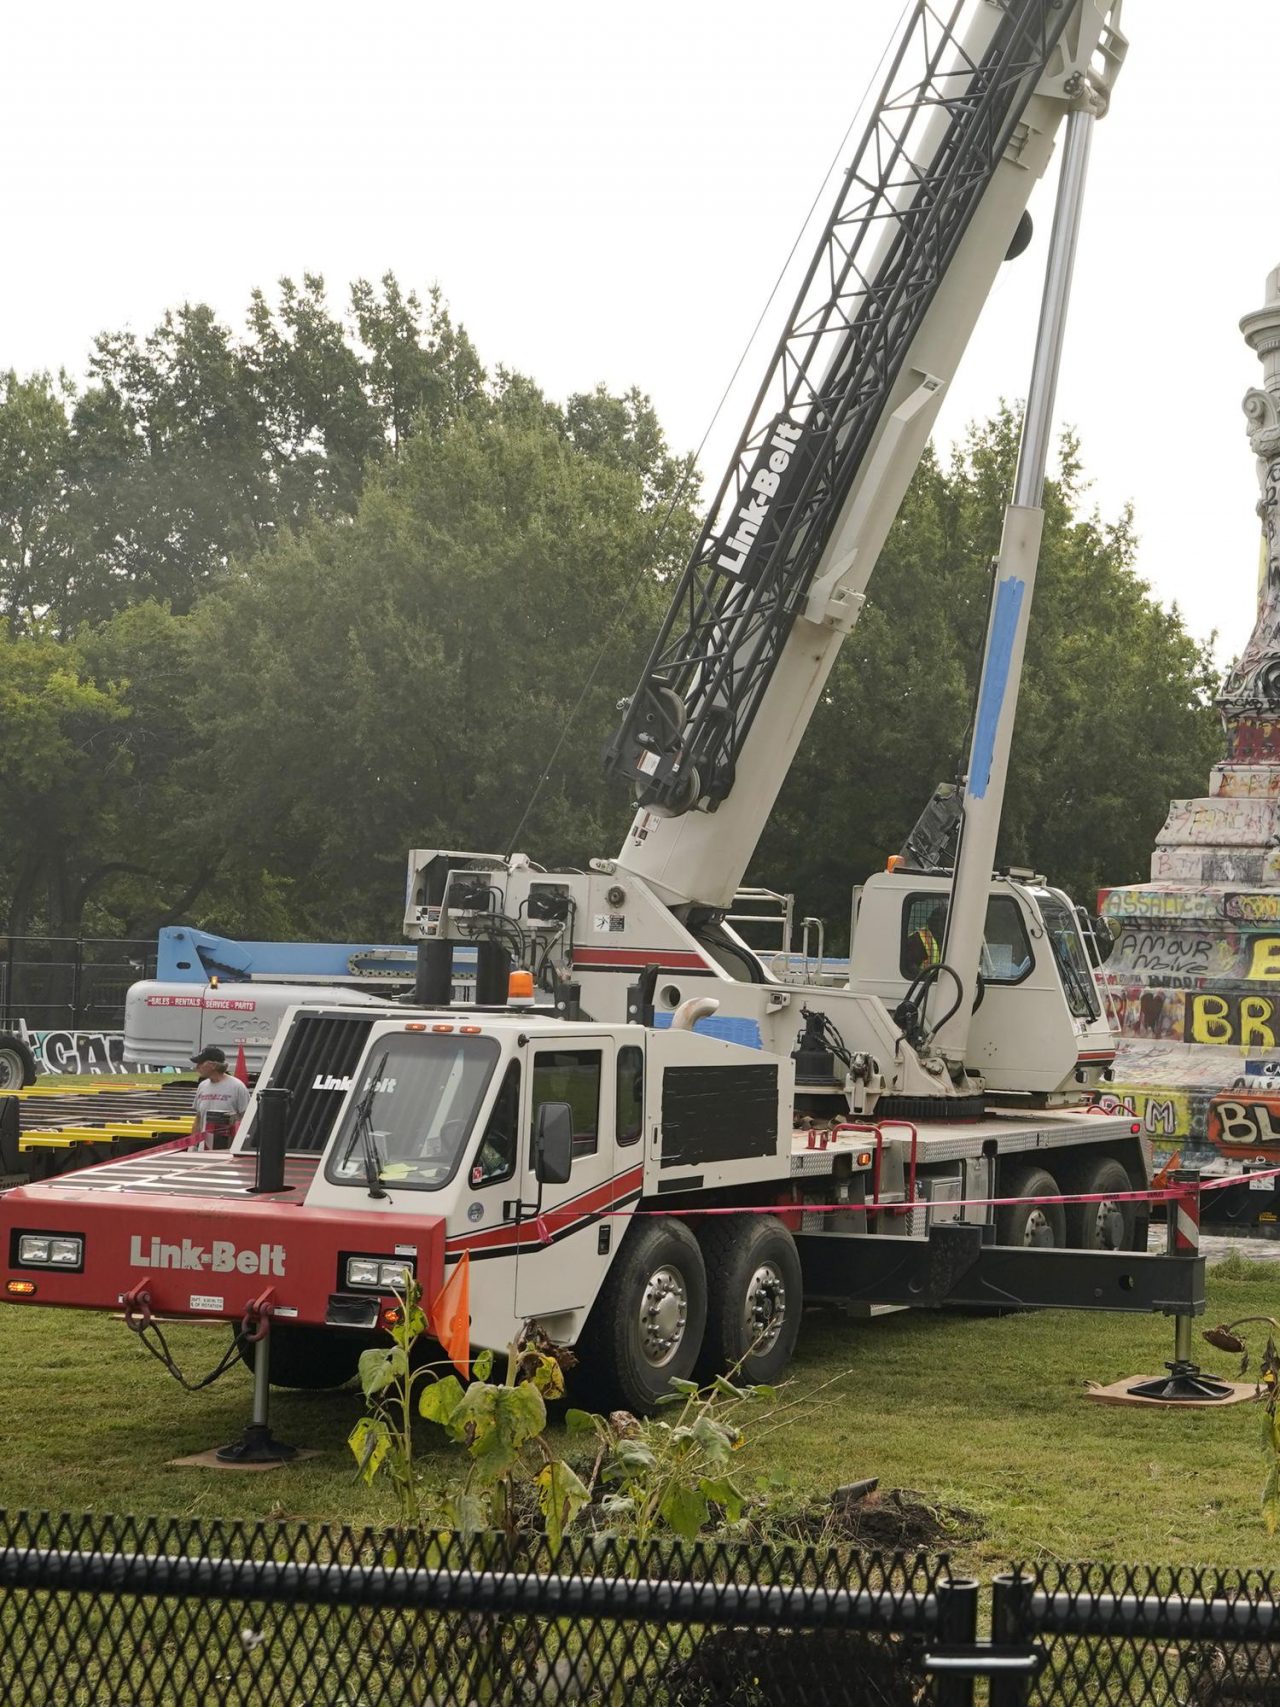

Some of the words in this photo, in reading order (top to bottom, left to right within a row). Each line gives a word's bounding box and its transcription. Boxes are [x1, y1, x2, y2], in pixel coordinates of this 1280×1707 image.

[717, 422, 803, 575] Link-Belt
[1120, 934, 1213, 960] AMOUR
[150, 997, 170, 1006] SALES
[174, 998, 201, 1007] RENTALS
[205, 1000, 230, 1009] SERVICE
[234, 1001, 254, 1011] PARTS
[213, 1015, 271, 1031] Genie
[129, 1235, 287, 1277] Link-Belt
